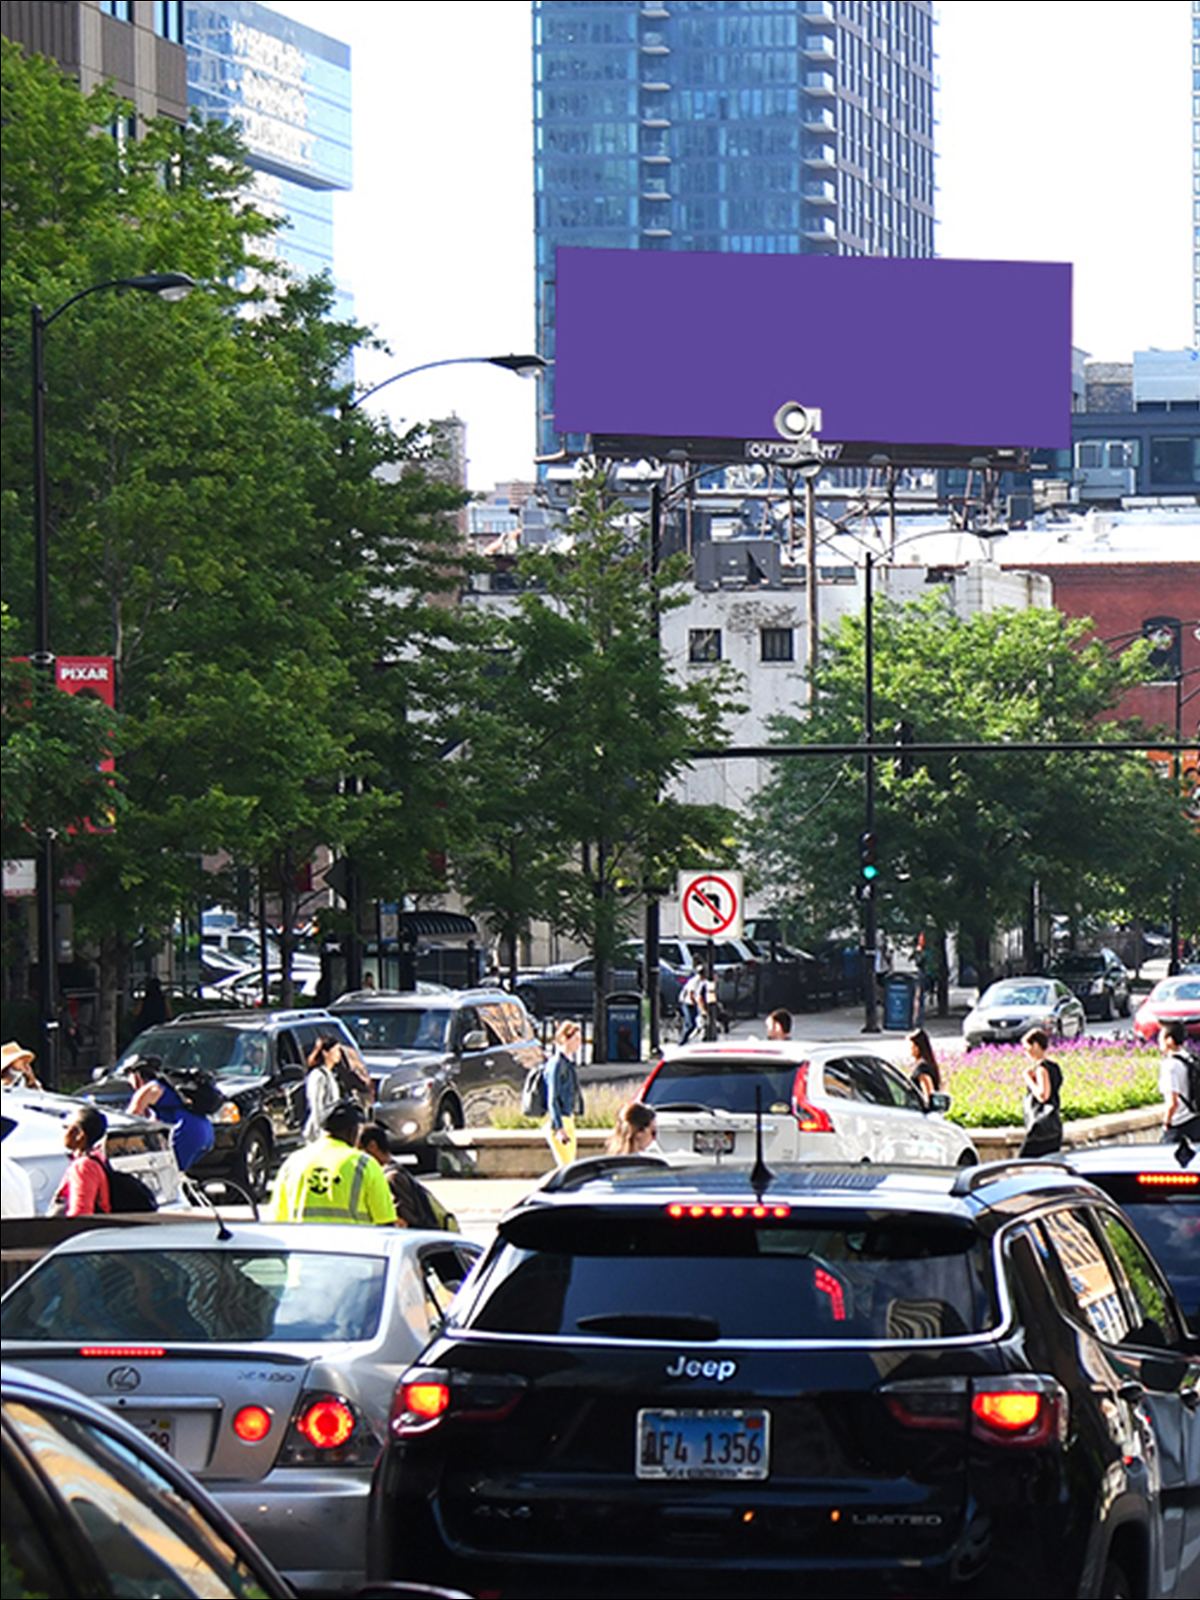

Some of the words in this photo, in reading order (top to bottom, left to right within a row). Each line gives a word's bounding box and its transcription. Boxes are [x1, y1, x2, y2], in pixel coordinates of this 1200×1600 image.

[60, 667, 109, 681] PIXAR
[665, 1356, 737, 1381] Jeep
[702, 1431, 762, 1465] 1356
